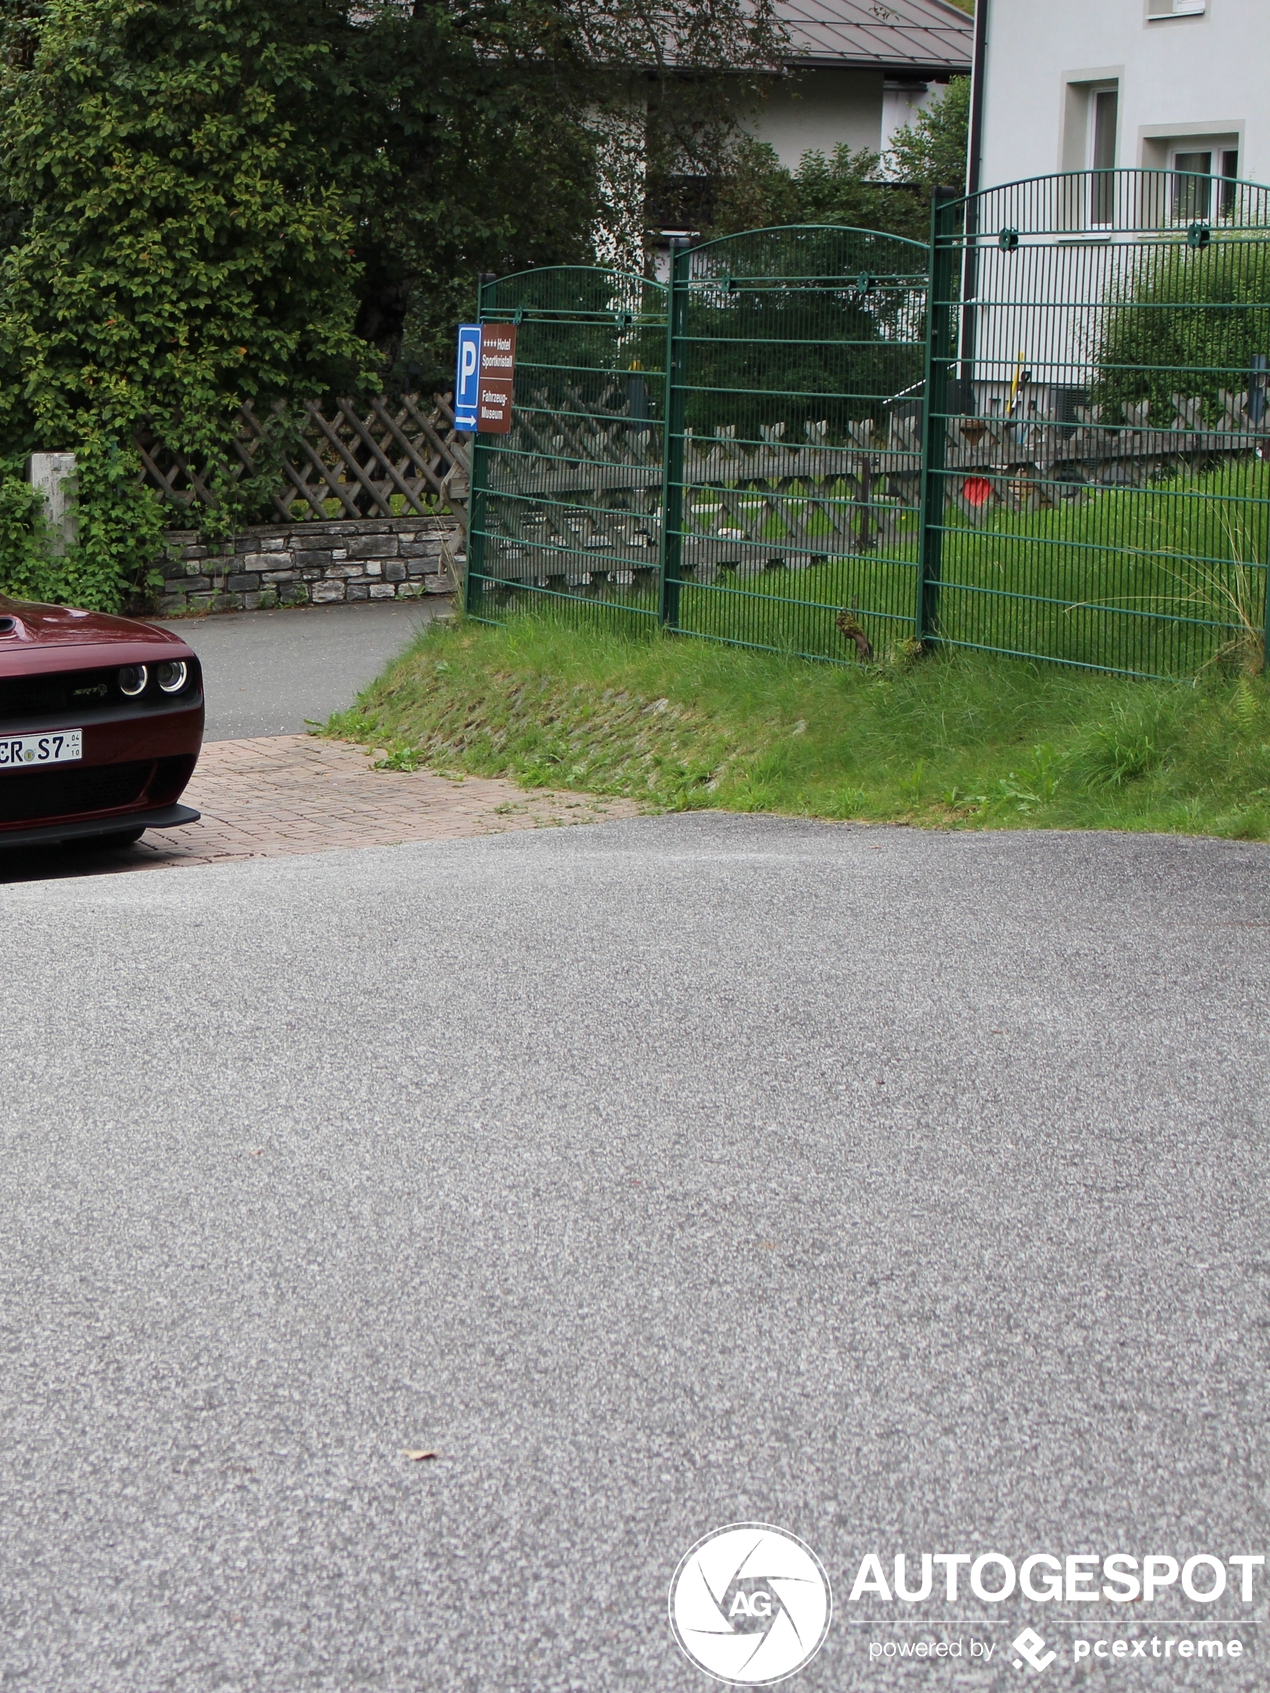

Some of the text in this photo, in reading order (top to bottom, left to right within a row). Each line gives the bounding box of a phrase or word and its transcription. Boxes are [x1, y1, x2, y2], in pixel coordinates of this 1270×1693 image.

[496, 338, 511, 351] Hotel
[460, 341, 477, 395] P
[481, 354, 513, 369] Sportkristall
[481, 390, 508, 406] Fahrzeug-
[481, 406, 503, 420] Museum
